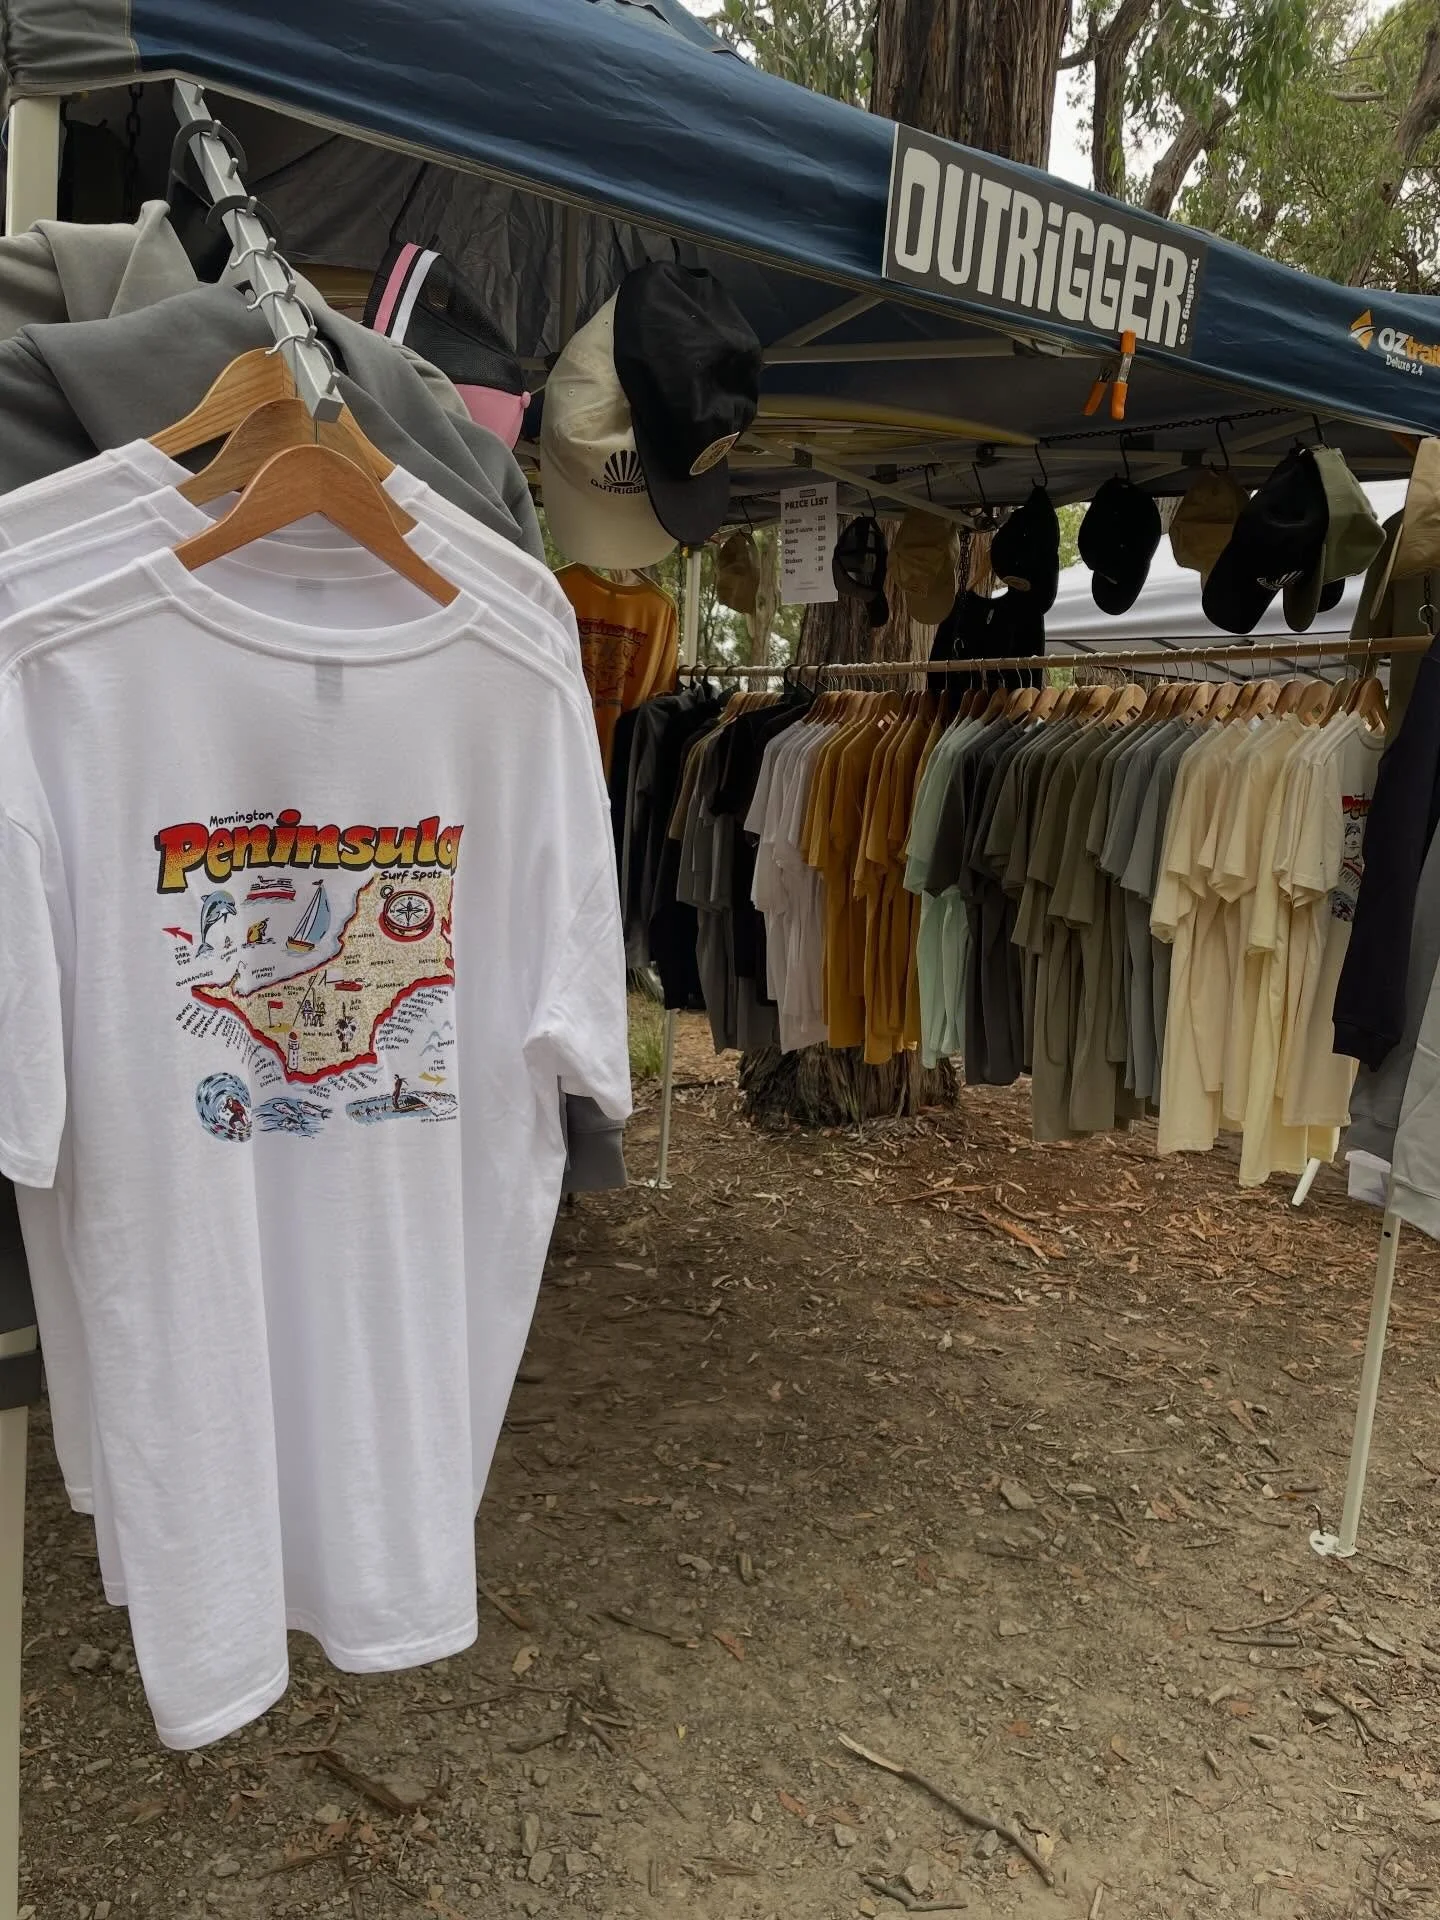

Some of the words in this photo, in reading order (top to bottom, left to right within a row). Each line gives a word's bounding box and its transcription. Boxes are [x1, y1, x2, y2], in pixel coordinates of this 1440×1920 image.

[1385, 354, 1411, 372] Deluxe
[1411, 362, 1423, 376] 2.4
[784, 499, 809, 510] PRICE
[810, 496, 828, 506] LIST
[208, 809, 275, 828] Mornington
[154, 808, 464, 894] Peninsula
[379, 871, 408, 884] Surf
[411, 869, 443, 882] Spots
